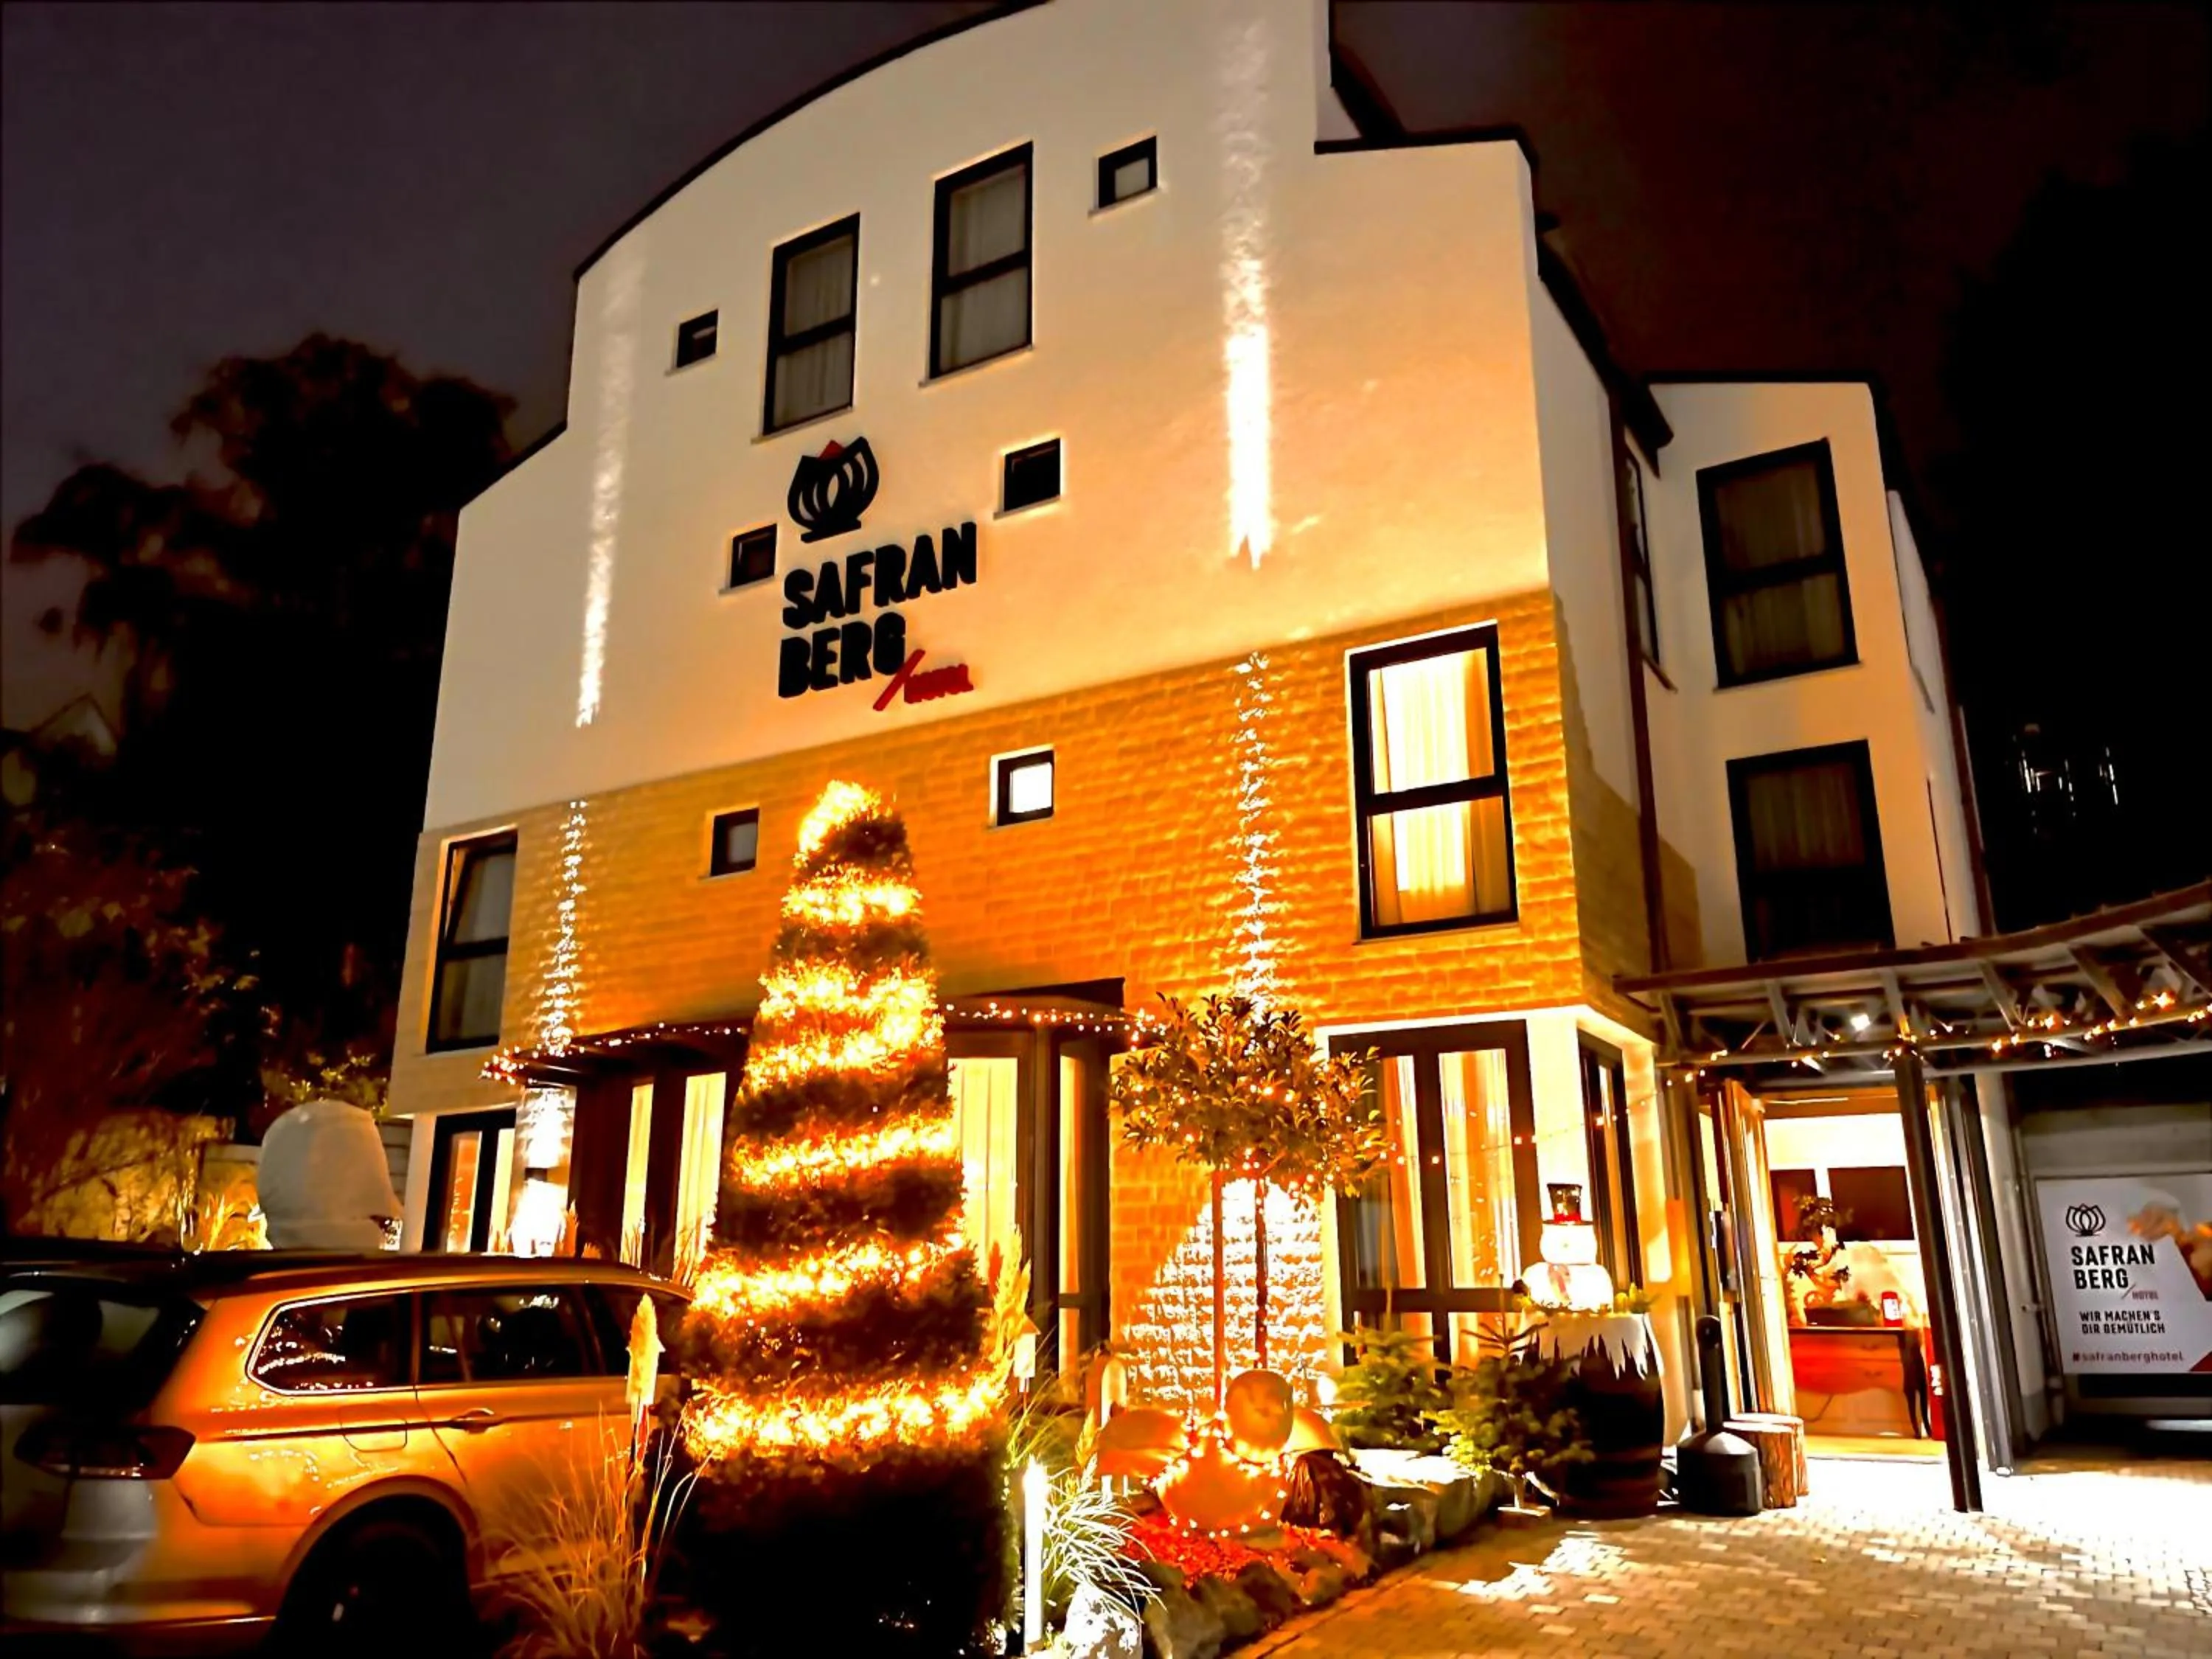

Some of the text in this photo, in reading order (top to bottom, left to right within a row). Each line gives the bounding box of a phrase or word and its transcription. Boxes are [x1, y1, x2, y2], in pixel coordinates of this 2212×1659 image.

[782, 521, 977, 629] SAFRAN
[778, 611, 906, 698] BERG
[2070, 1243, 2155, 1266] SAFRAN
[2073, 1268, 2129, 1290] BERG
[2079, 1310, 2101, 1322] WIR
[2081, 1324, 2101, 1335] DIR
